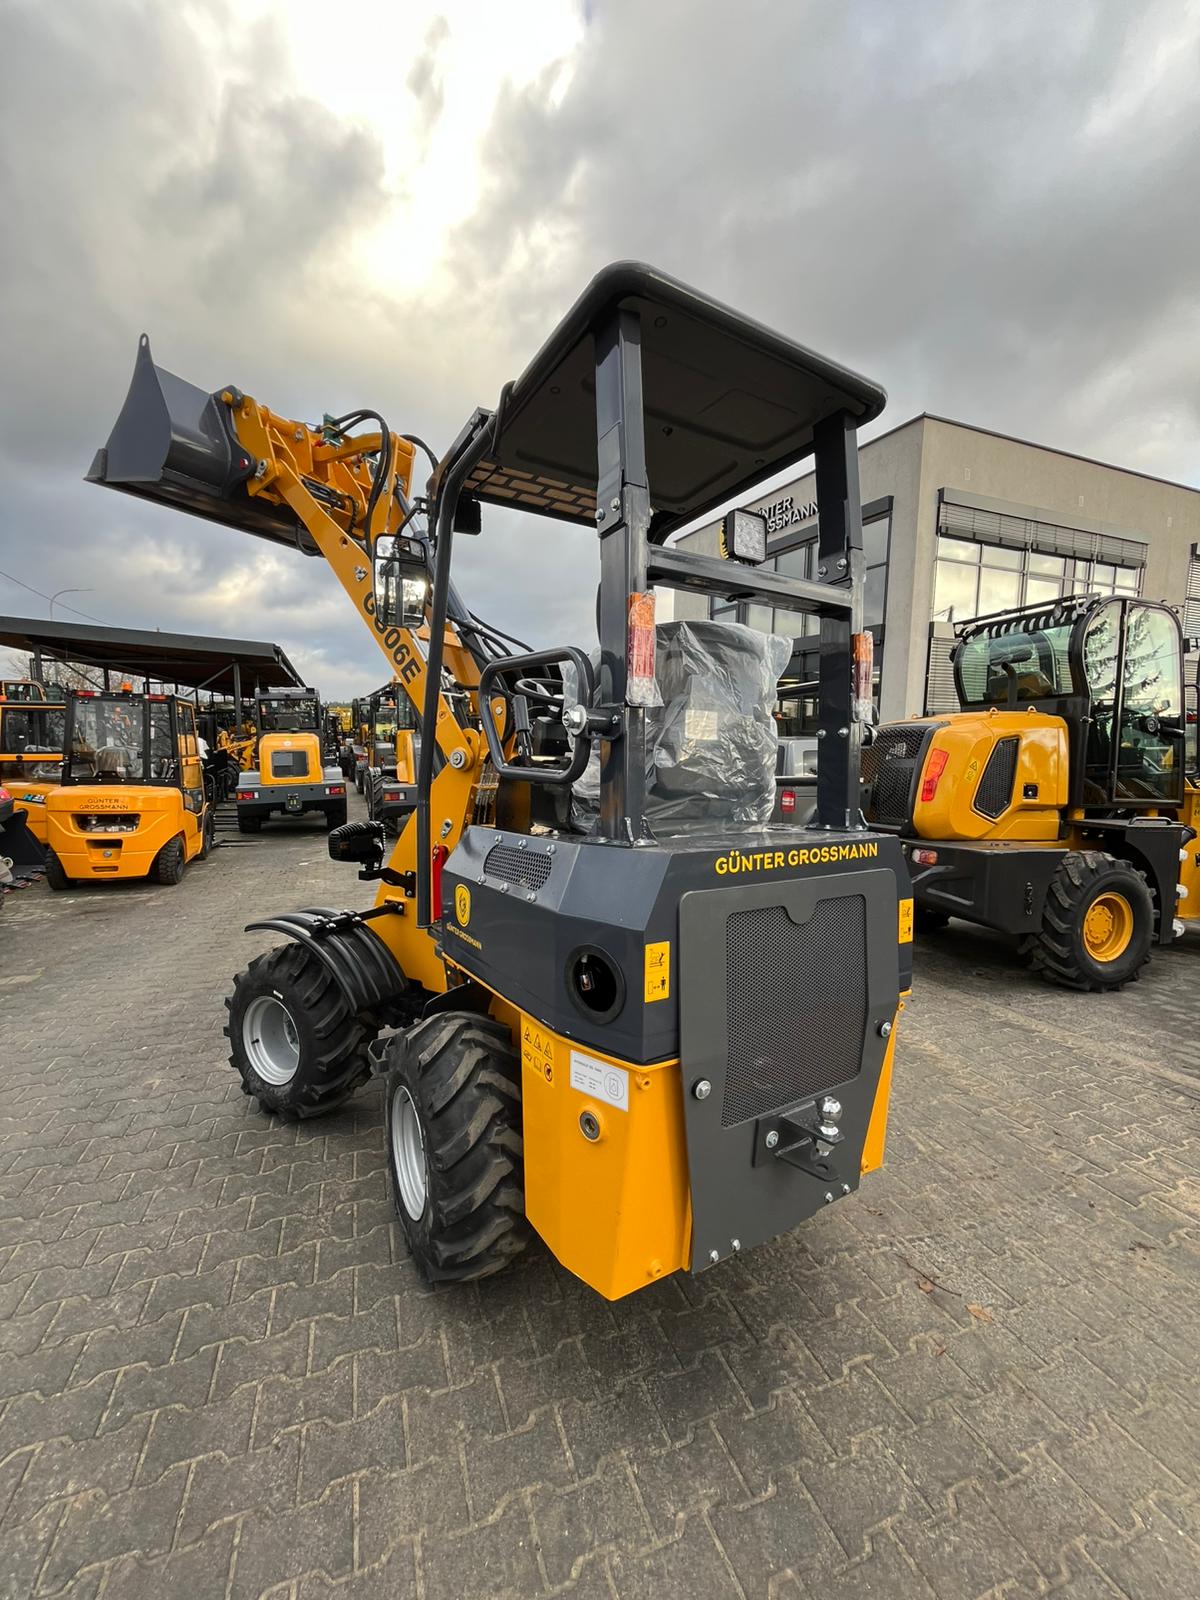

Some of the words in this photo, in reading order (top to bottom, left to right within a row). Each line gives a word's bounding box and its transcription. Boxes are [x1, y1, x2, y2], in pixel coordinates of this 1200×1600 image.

[758, 496, 793, 518] NTER
[767, 501, 818, 533] SSMANN
[715, 850, 785, 875] GÜNTER
[788, 843, 878, 866] GROSSMANN
